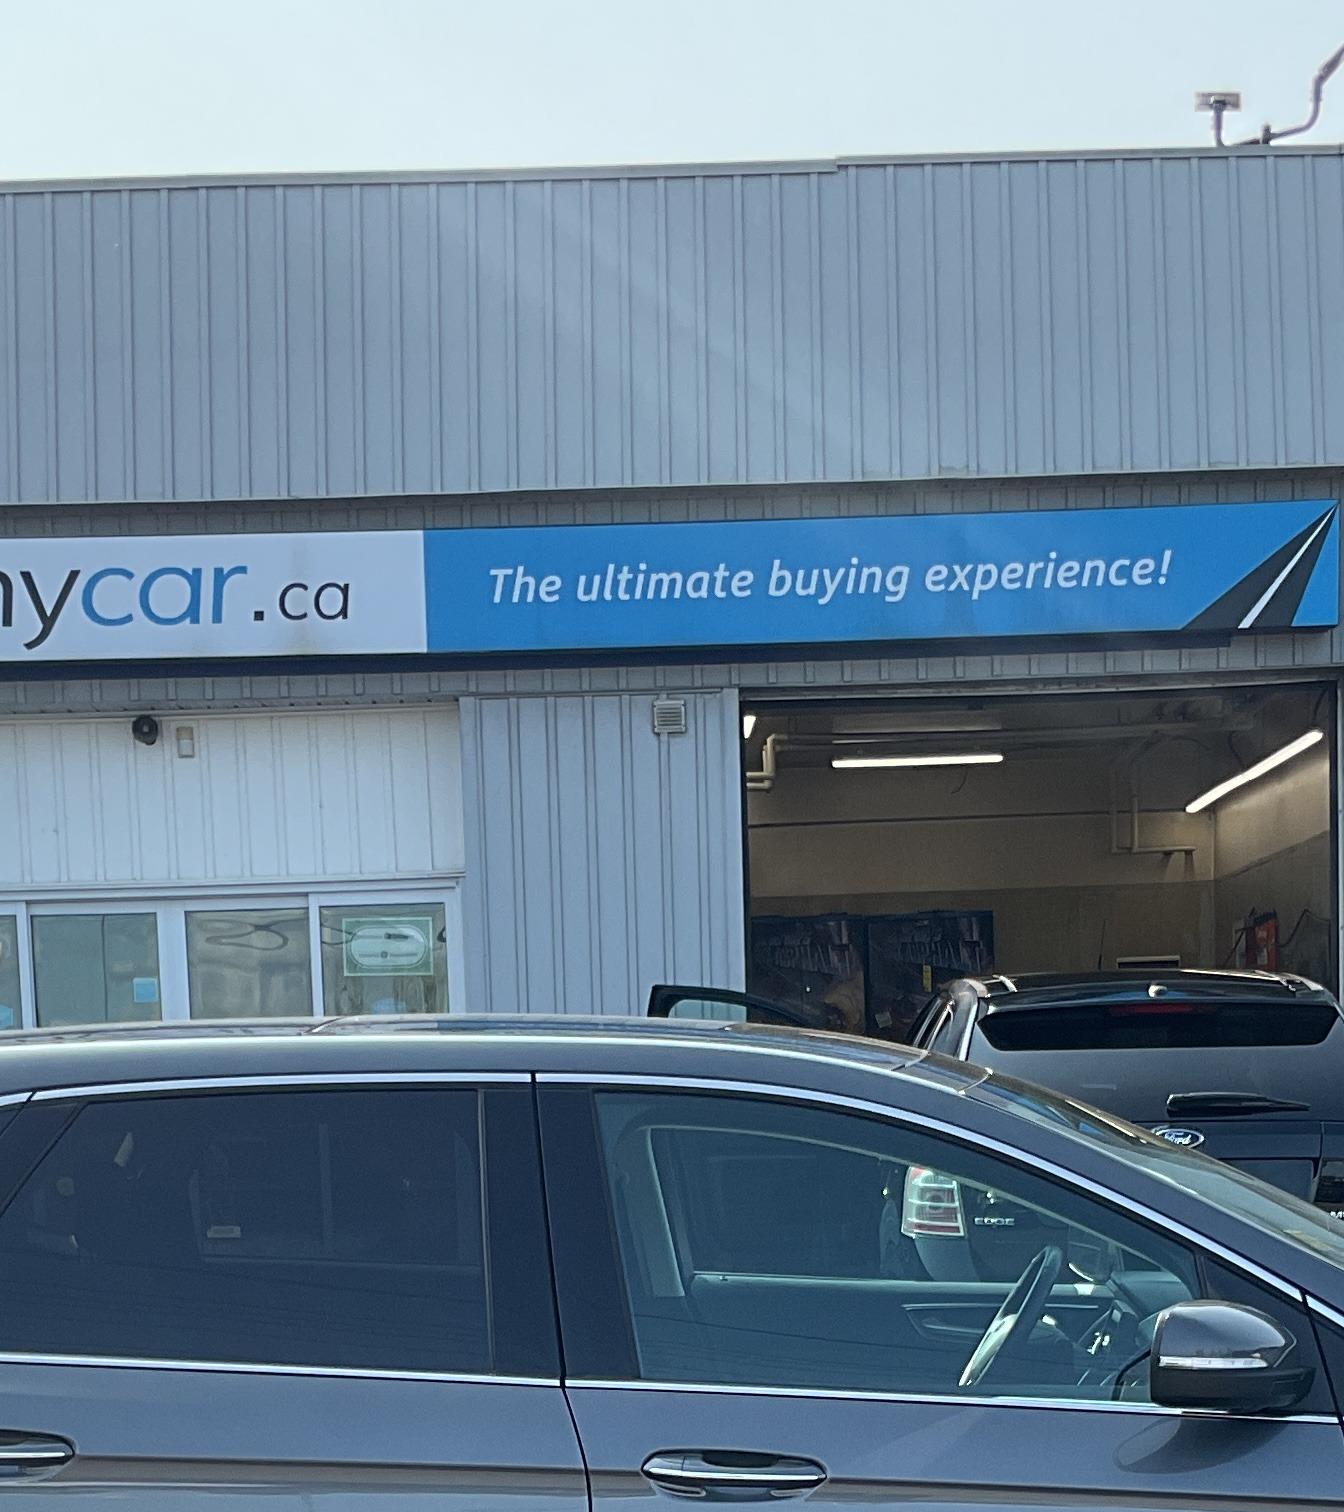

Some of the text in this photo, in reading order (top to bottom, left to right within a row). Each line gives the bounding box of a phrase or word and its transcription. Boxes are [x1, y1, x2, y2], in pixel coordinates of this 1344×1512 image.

[489, 549, 1172, 606] The ultimate buying experience!
